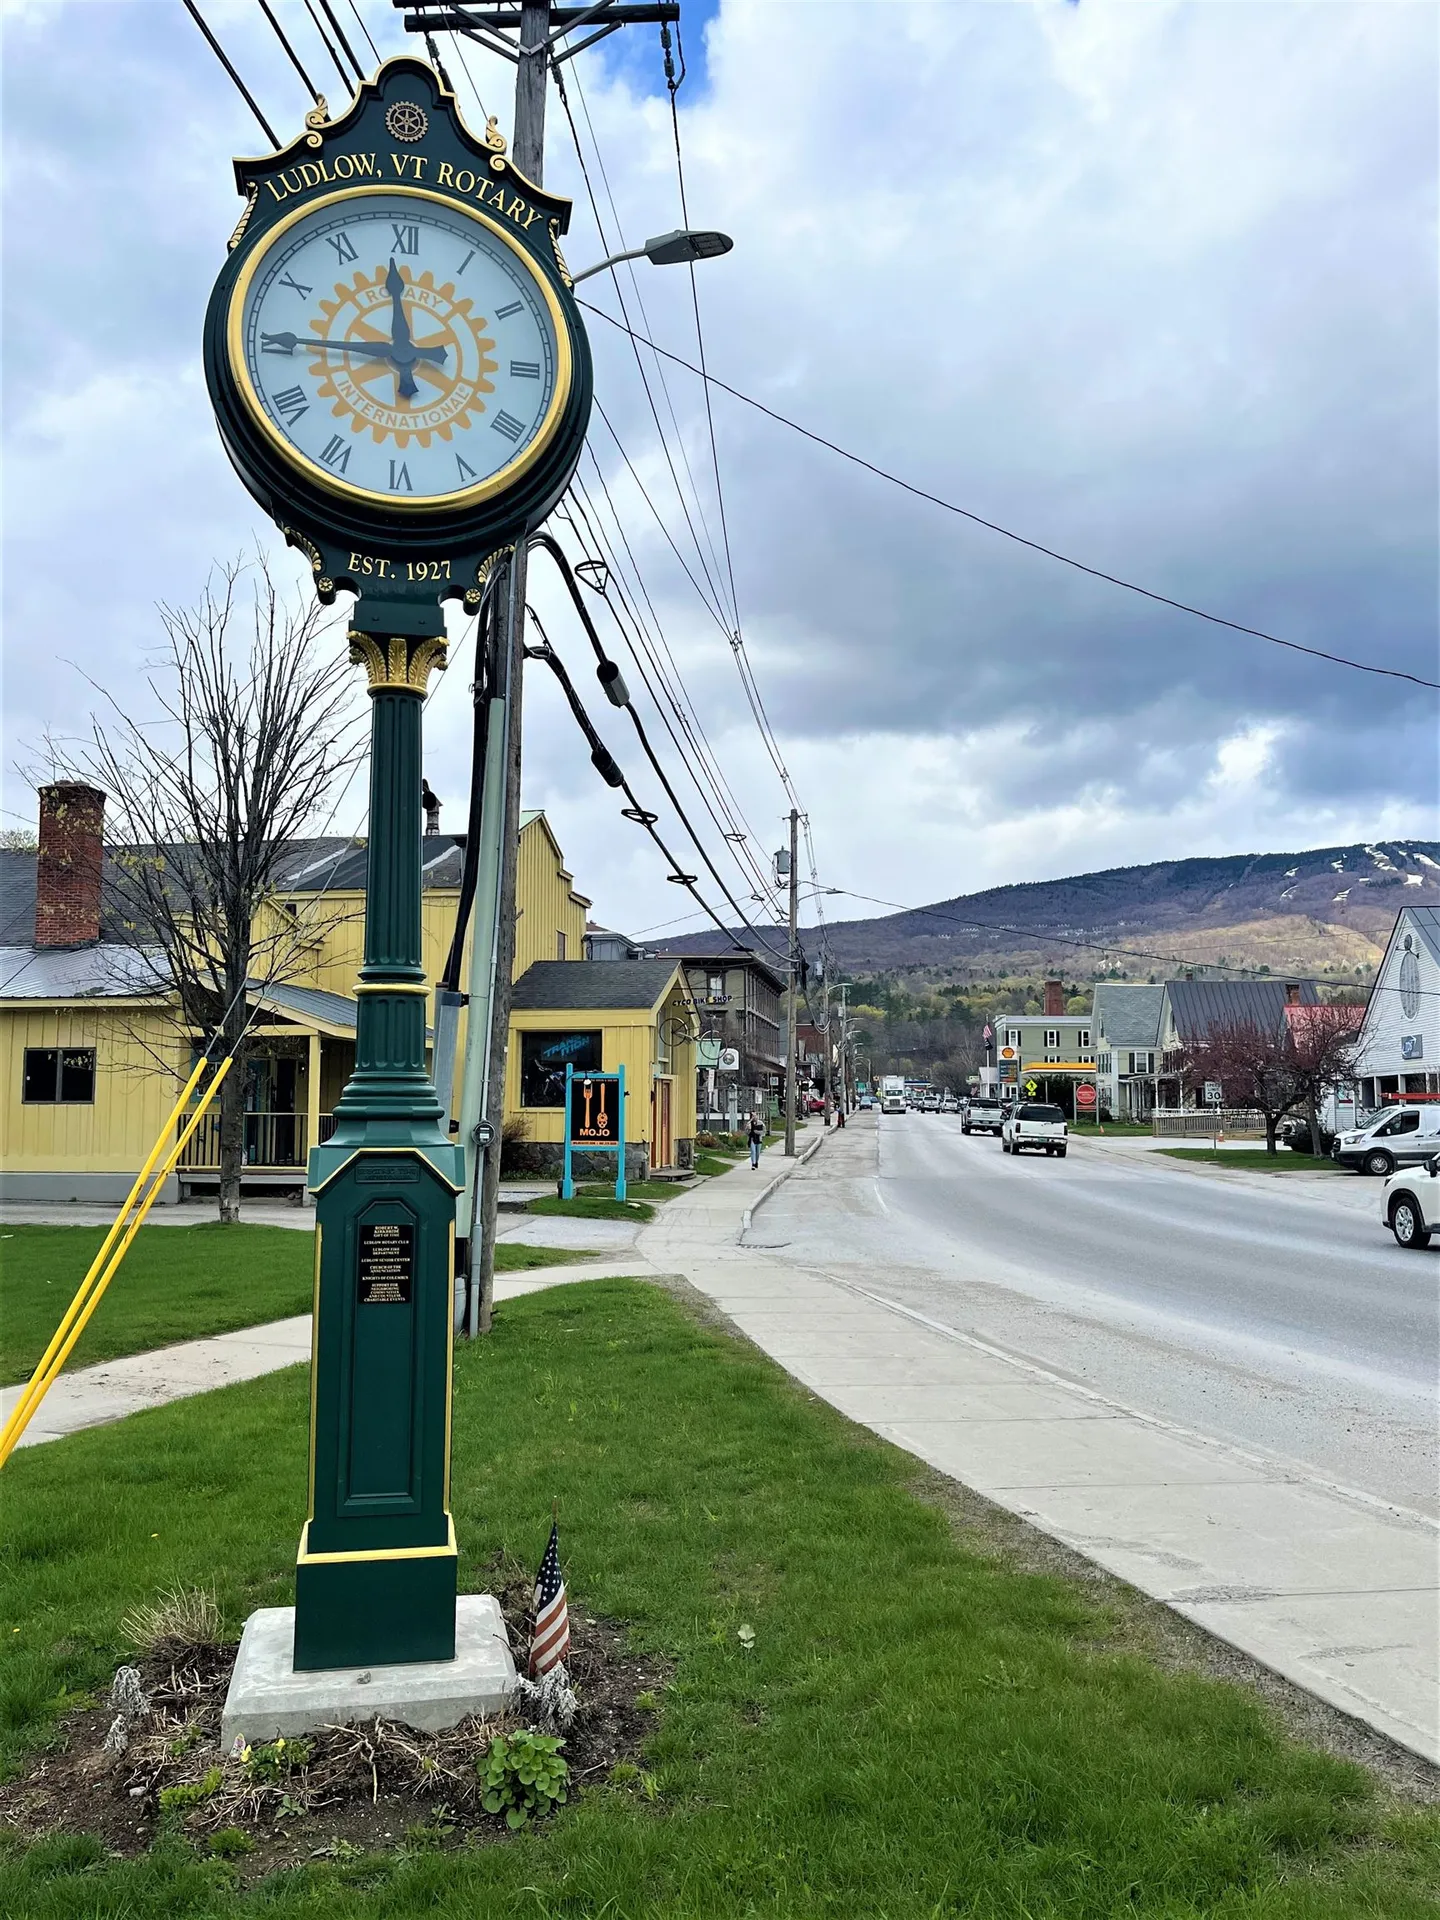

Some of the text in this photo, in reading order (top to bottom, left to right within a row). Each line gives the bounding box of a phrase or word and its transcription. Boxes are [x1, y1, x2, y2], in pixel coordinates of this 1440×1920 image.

[264, 152, 543, 231] LUDLOW, VT ROTARY
[325, 231, 359, 265] XI
[391, 224, 419, 255] XII
[456, 250, 476, 275] I
[278, 272, 313, 300] X
[365, 285, 445, 308] ROARY
[494, 300, 526, 320] II
[510, 360, 540, 380] III
[272, 385, 311, 427] VIII
[319, 434, 353, 474] VII
[455, 453, 477, 482] V
[389, 460, 413, 491] VI
[348, 552, 451, 581] EST. 1927
[712, 995, 732, 1003] SHOP
[580, 1128, 610, 1136] MOJO
